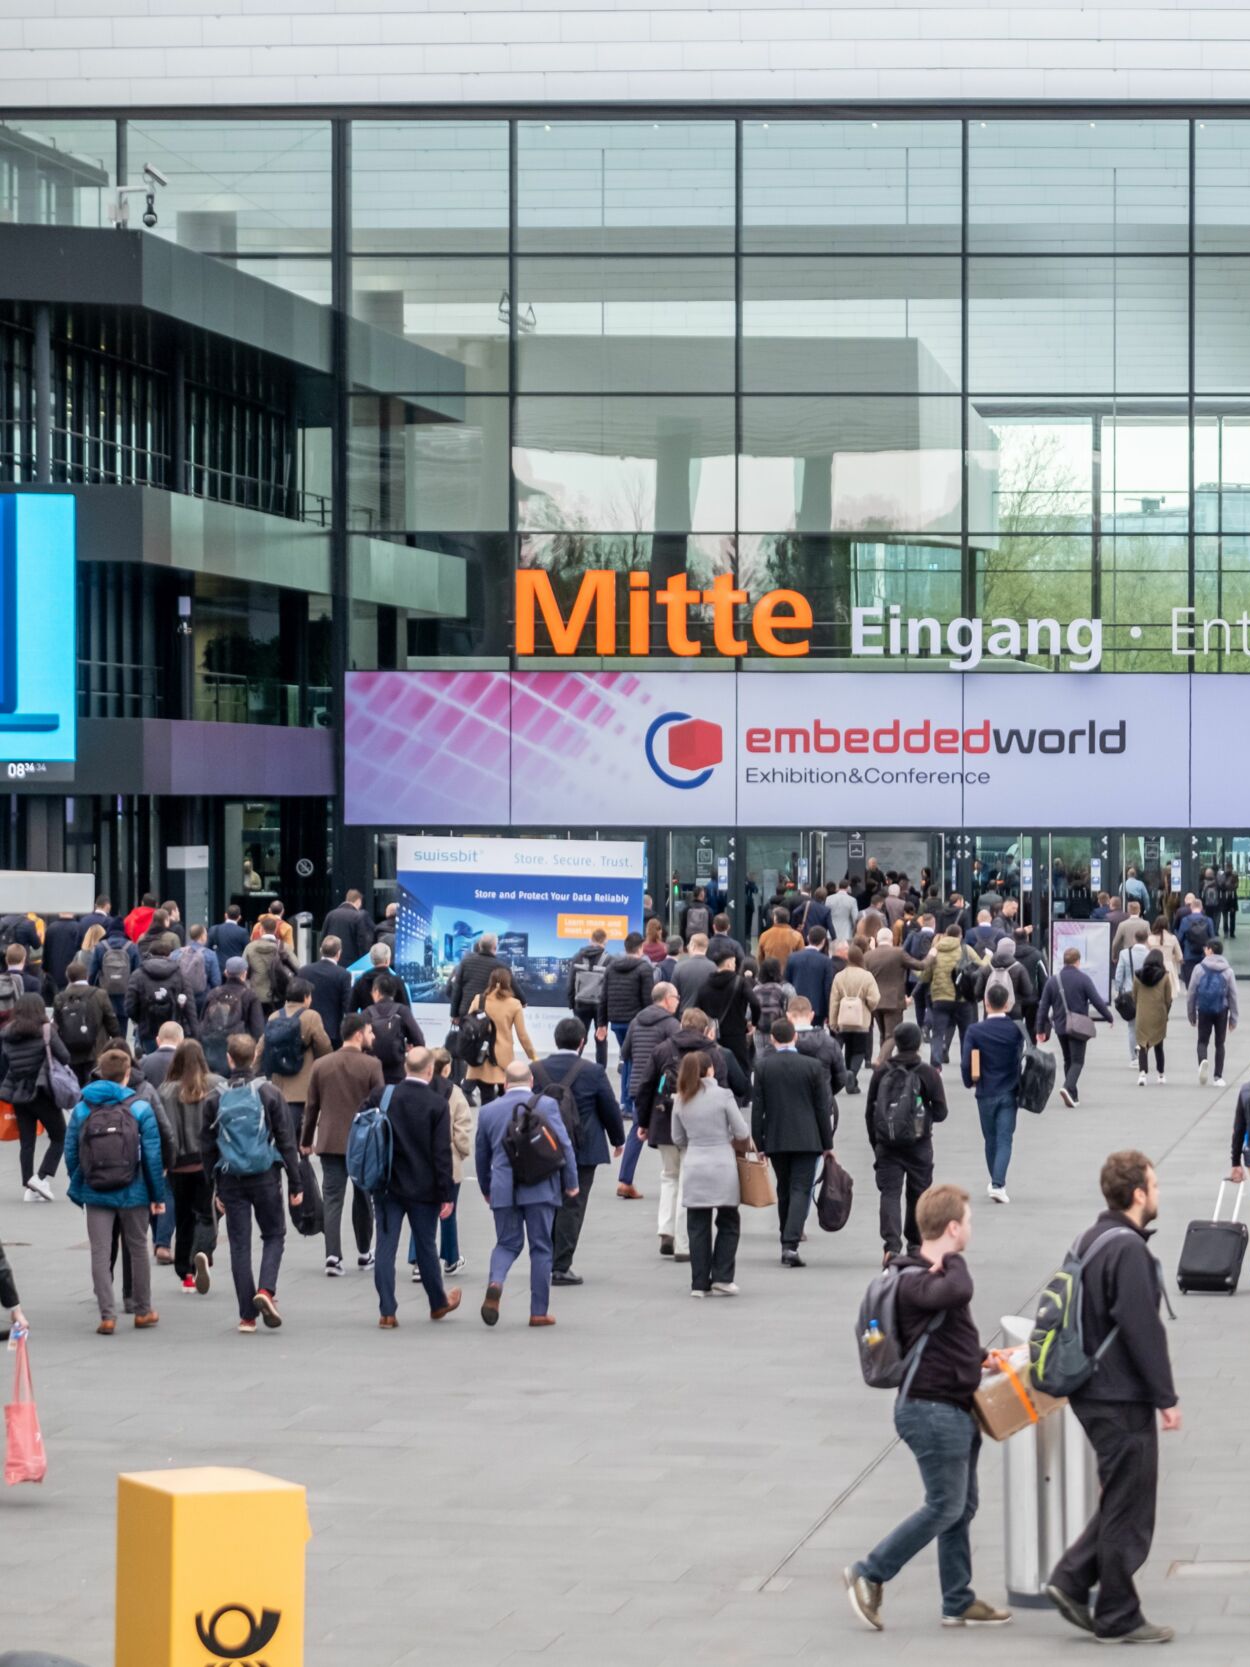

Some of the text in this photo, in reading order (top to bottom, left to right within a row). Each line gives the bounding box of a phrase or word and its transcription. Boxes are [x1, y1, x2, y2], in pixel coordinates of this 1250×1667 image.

[515, 569, 814, 657] Mitte
[850, 606, 1103, 671] Eingang
[745, 719, 1127, 754] embeddedworld
[745, 767, 991, 785] Exhibition&Conference
[513, 852, 634, 868] Store. Secure. Trust.
[474, 888, 630, 905] Store and Protect Your Data Reliably
